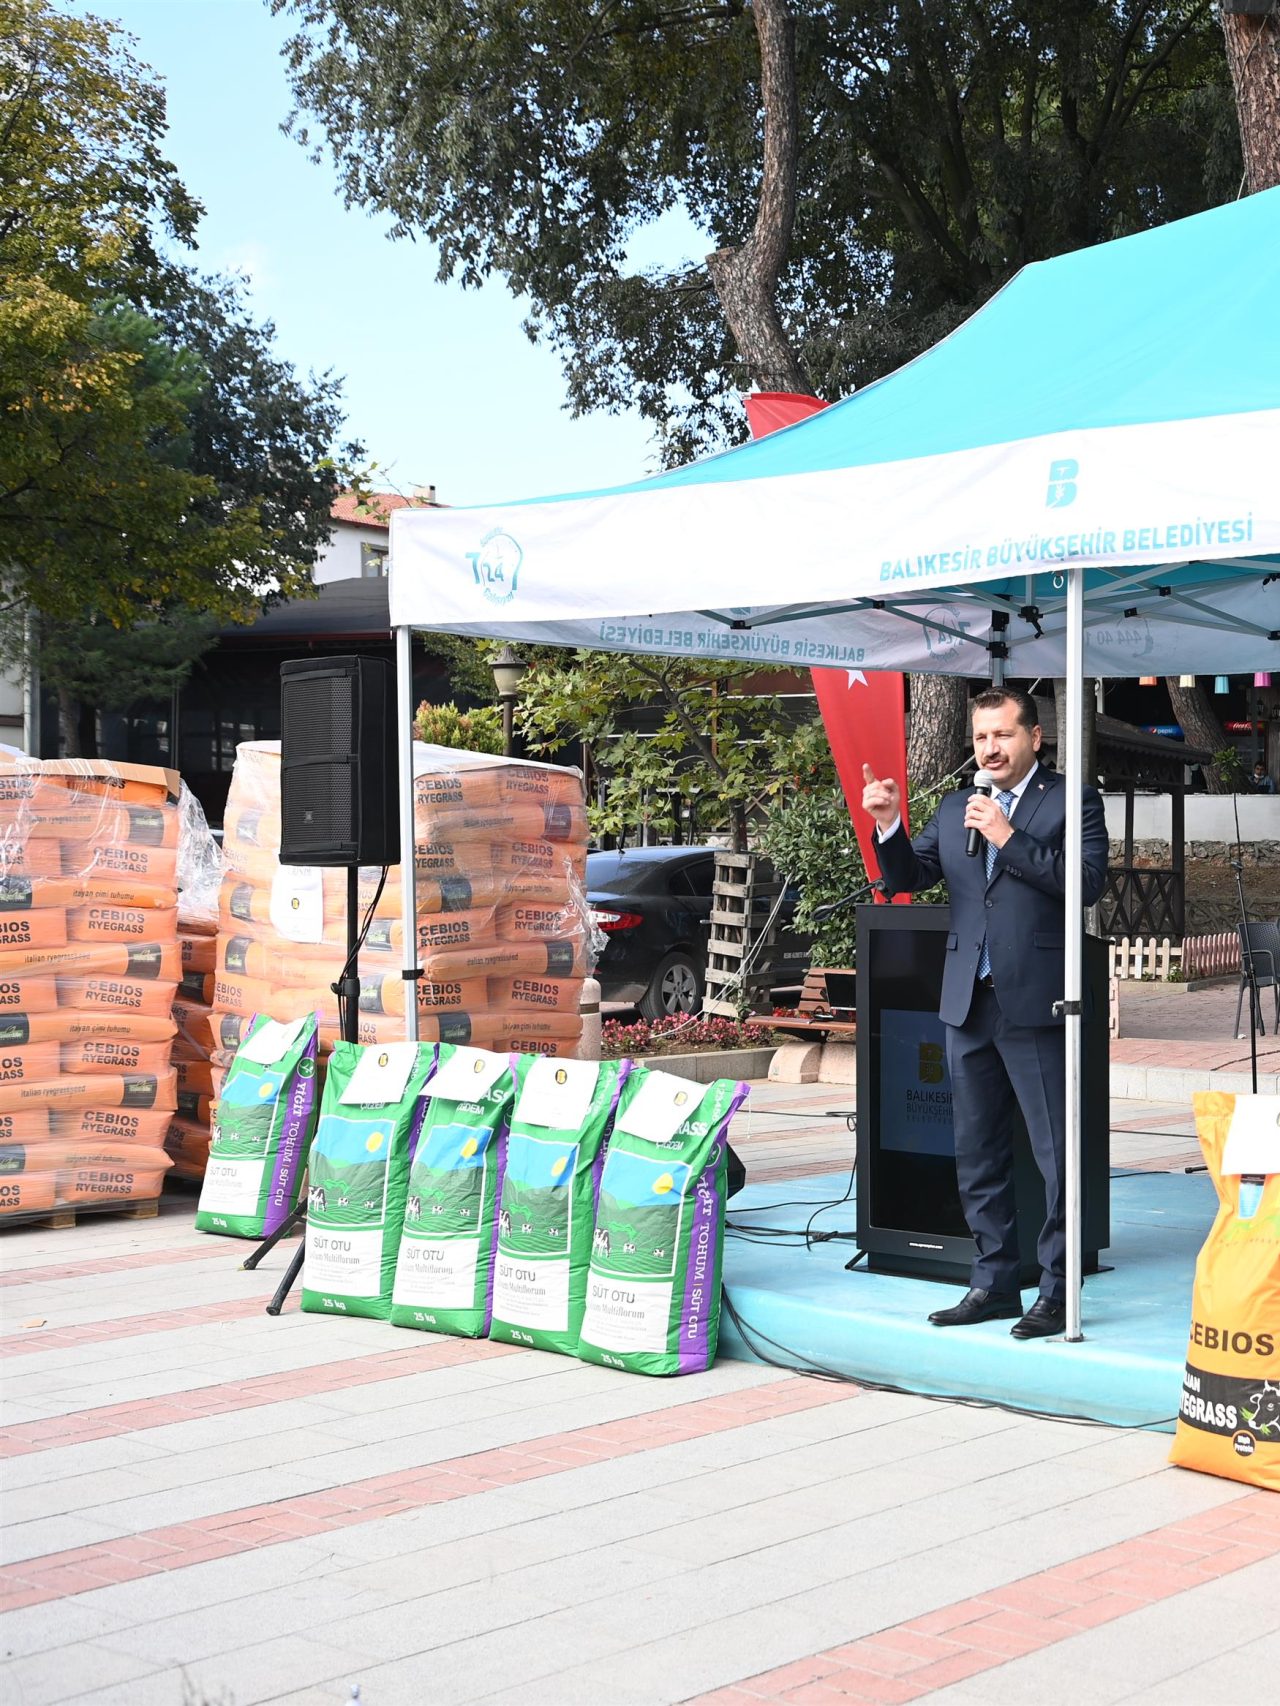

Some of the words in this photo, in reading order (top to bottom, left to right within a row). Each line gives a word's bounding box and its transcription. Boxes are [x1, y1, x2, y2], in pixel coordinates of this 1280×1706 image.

[880, 544, 982, 582] BALIKESİR
[987, 526, 1116, 566] BÜYÜKŞEHİR
[1122, 512, 1254, 552] BELEDİYESİ
[416, 778, 462, 791] CEBIOS
[506, 780, 549, 794] RYEGRASS
[417, 791, 463, 804] RYEGRASS
[512, 842, 553, 856] CEBIOS
[89, 909, 145, 924] CEBIOS
[515, 909, 562, 922] CEBIOS
[88, 920, 144, 934] RYEGRASS
[419, 921, 470, 936] CEBIOS
[420, 933, 471, 947] RYEGRASS
[87, 980, 143, 997] CEBIOS
[513, 980, 559, 995] CEBIOS
[85, 991, 142, 1008] RYEGRASS
[512, 991, 558, 1006] RYEGRASS
[84, 1041, 140, 1056] CEBIOS
[510, 1040, 557, 1053] CEBIOS
[82, 1053, 138, 1067] RYEGRASS
[84, 1110, 139, 1127] CEBIOS
[81, 1122, 137, 1137] RYEGRASS
[283, 1121, 300, 1163] TOHUM
[77, 1171, 134, 1184] CEBIOS
[76, 1183, 132, 1194] RYEGRASS
[314, 1236, 328, 1248] SÜT
[330, 1239, 352, 1252] OTU
[406, 1247, 420, 1259] SÜT
[422, 1250, 445, 1261] OTU
[694, 1223, 710, 1281] TOHUM
[499, 1266, 514, 1279] SÜT
[515, 1270, 536, 1282] OTU
[592, 1284, 609, 1299] SÜT
[611, 1290, 635, 1304] OTU
[691, 1288, 702, 1313] SÜT
[322, 1298, 333, 1308] 25
[334, 1300, 347, 1311] kg
[413, 1312, 424, 1321] 25
[425, 1313, 436, 1324] kg
[687, 1315, 698, 1340] OTU
[510, 1329, 521, 1340] 25
[522, 1331, 534, 1344] kg
[600, 1353, 612, 1365] 25
[613, 1355, 625, 1368] kg
